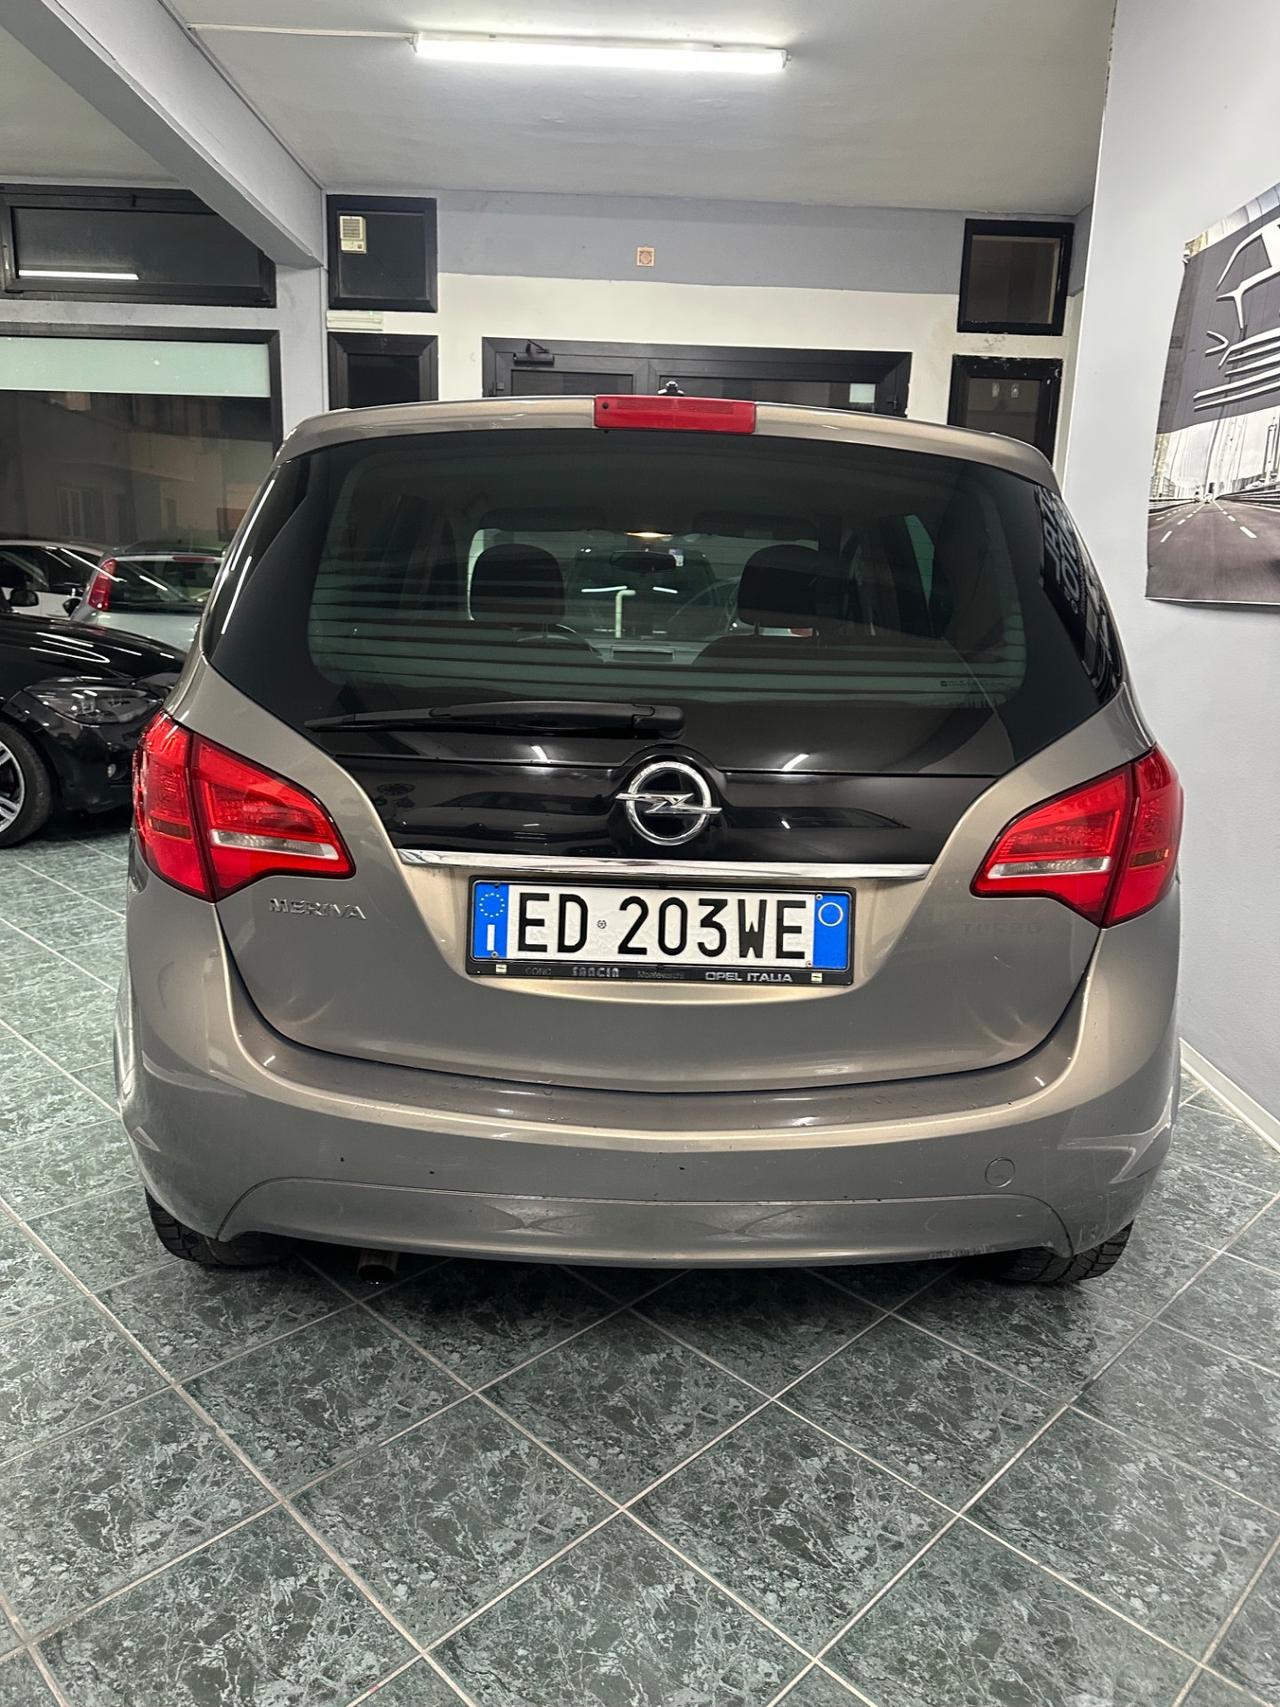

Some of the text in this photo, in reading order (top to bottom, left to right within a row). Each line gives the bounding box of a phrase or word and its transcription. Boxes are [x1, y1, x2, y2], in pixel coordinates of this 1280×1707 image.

[268, 898, 367, 920] MERIVA
[487, 924, 496, 951] I
[517, 892, 807, 960] ED 203WE
[704, 971, 793, 983] OPEL ITALIA
